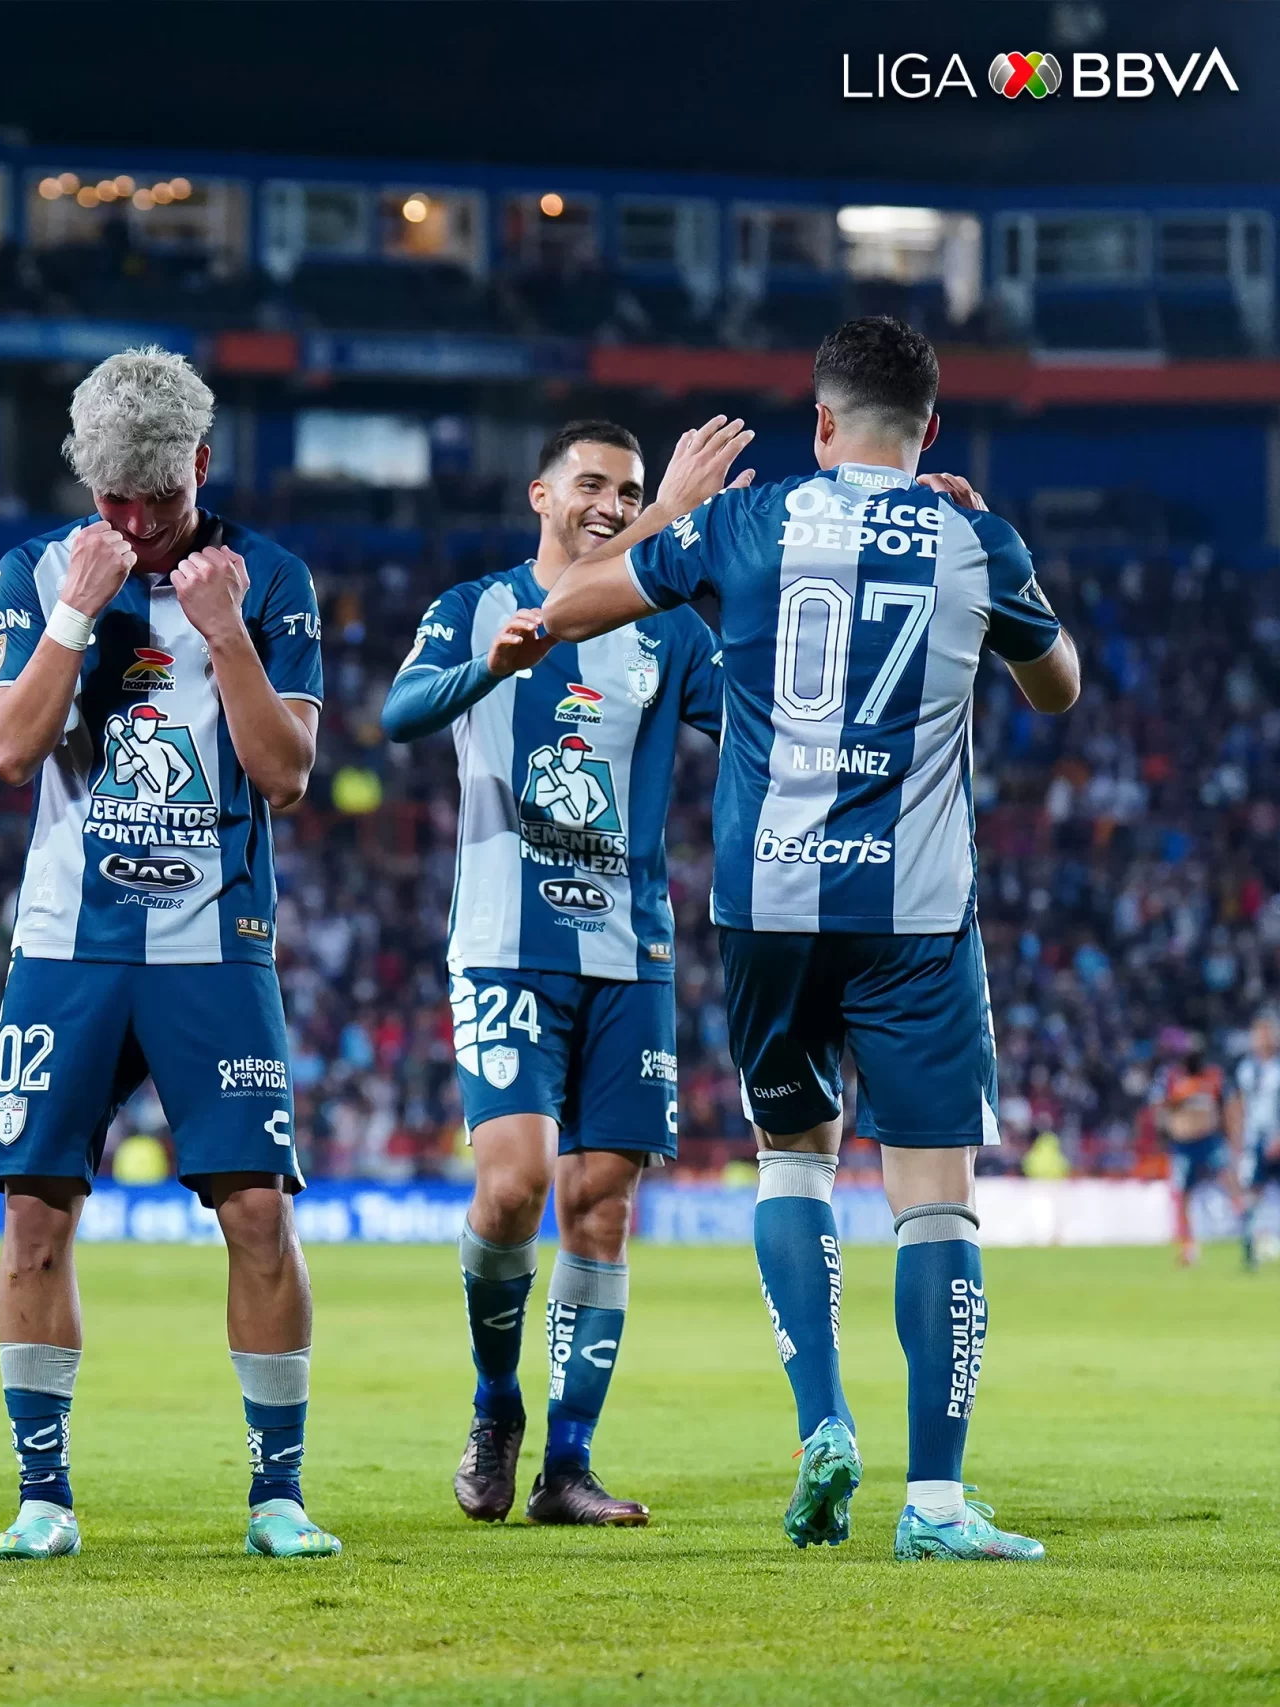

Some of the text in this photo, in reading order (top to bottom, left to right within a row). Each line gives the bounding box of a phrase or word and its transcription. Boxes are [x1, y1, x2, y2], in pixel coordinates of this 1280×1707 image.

[844, 470, 901, 488] CHARLY
[784, 487, 945, 531] Office
[778, 520, 943, 558] DEPOT
[773, 575, 938, 726] 07
[123, 680, 174, 691] ROSHFRANS
[792, 744, 891, 776] N. IBAÑEZ
[92, 800, 218, 828] CEMENTOS
[83, 820, 220, 847] FORTALEZA
[521, 823, 627, 854] CEMENTOS
[756, 829, 892, 864] betcris
[114, 858, 186, 881] JAC
[521, 839, 629, 876] FORTALEZA
[547, 885, 605, 906] JAC
[477, 985, 542, 1043] 24
[233, 1055, 286, 1074] HÉROES
[253, 1073, 287, 1090] VIDA
[753, 1081, 802, 1098] CHARLY
[553, 1301, 578, 1379] FORT
[947, 1278, 970, 1418] PEGAZULEJO
